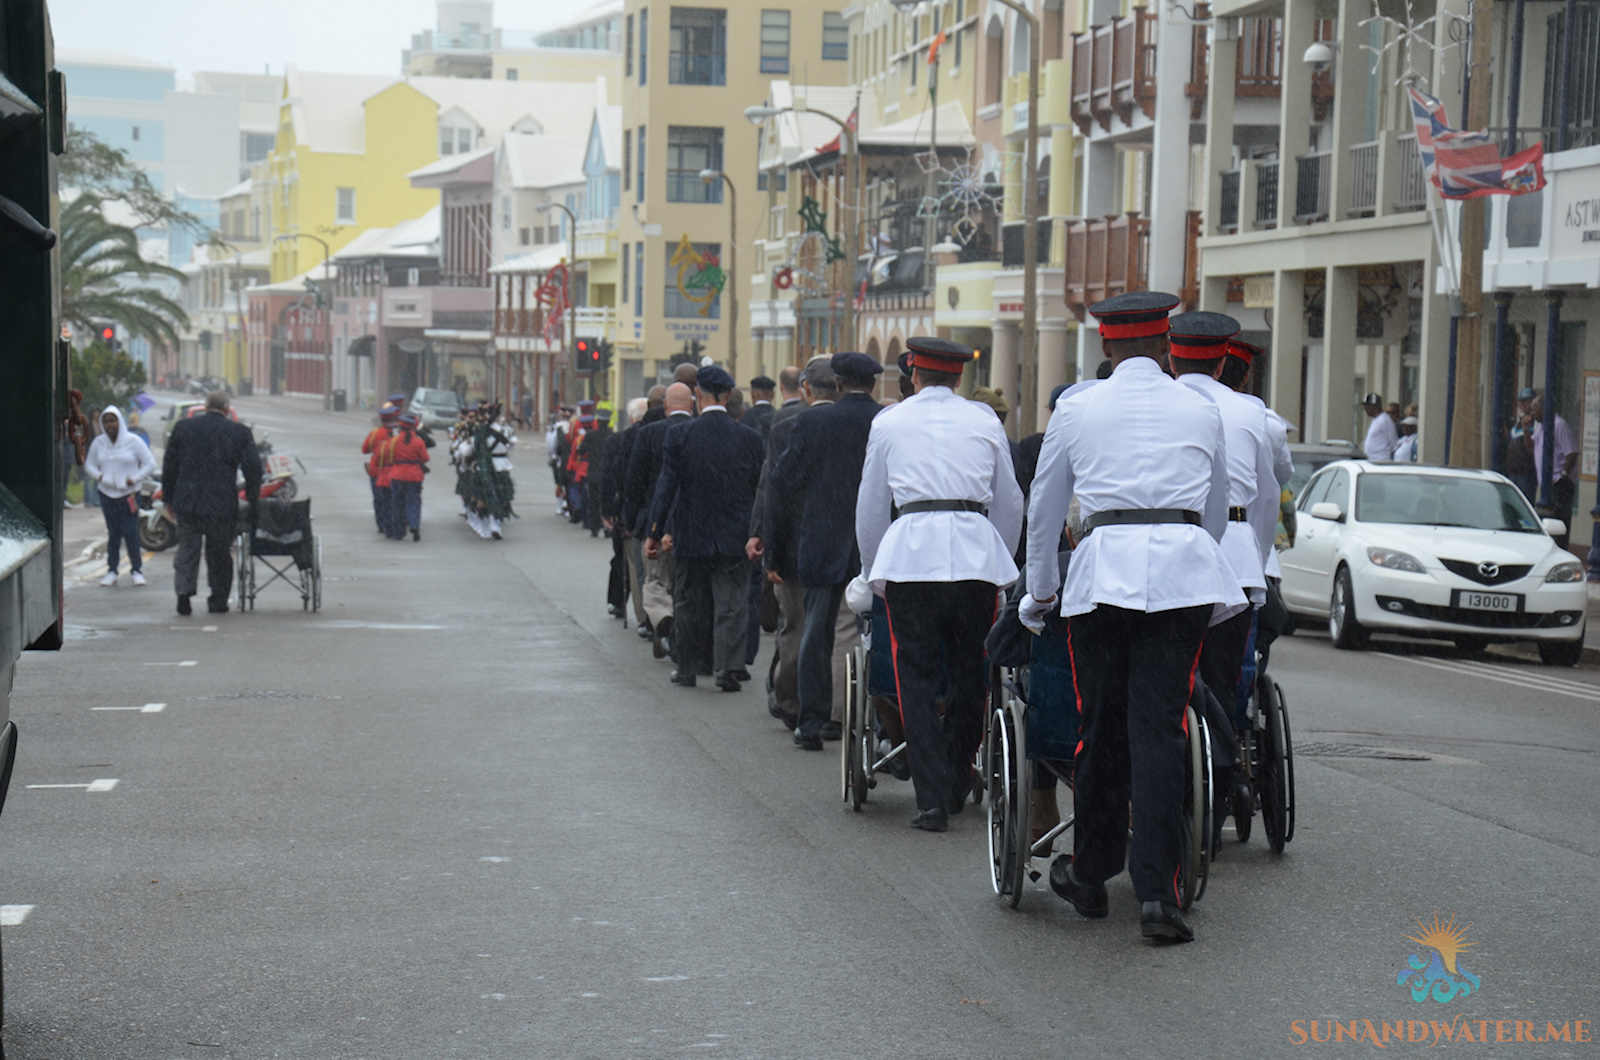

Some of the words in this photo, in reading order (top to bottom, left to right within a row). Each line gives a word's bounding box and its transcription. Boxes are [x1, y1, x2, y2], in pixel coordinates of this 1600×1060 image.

[665, 322, 719, 331] CHATHAM
[674, 332, 709, 341] HOUSE
[1469, 594, 1510, 609] 13000
